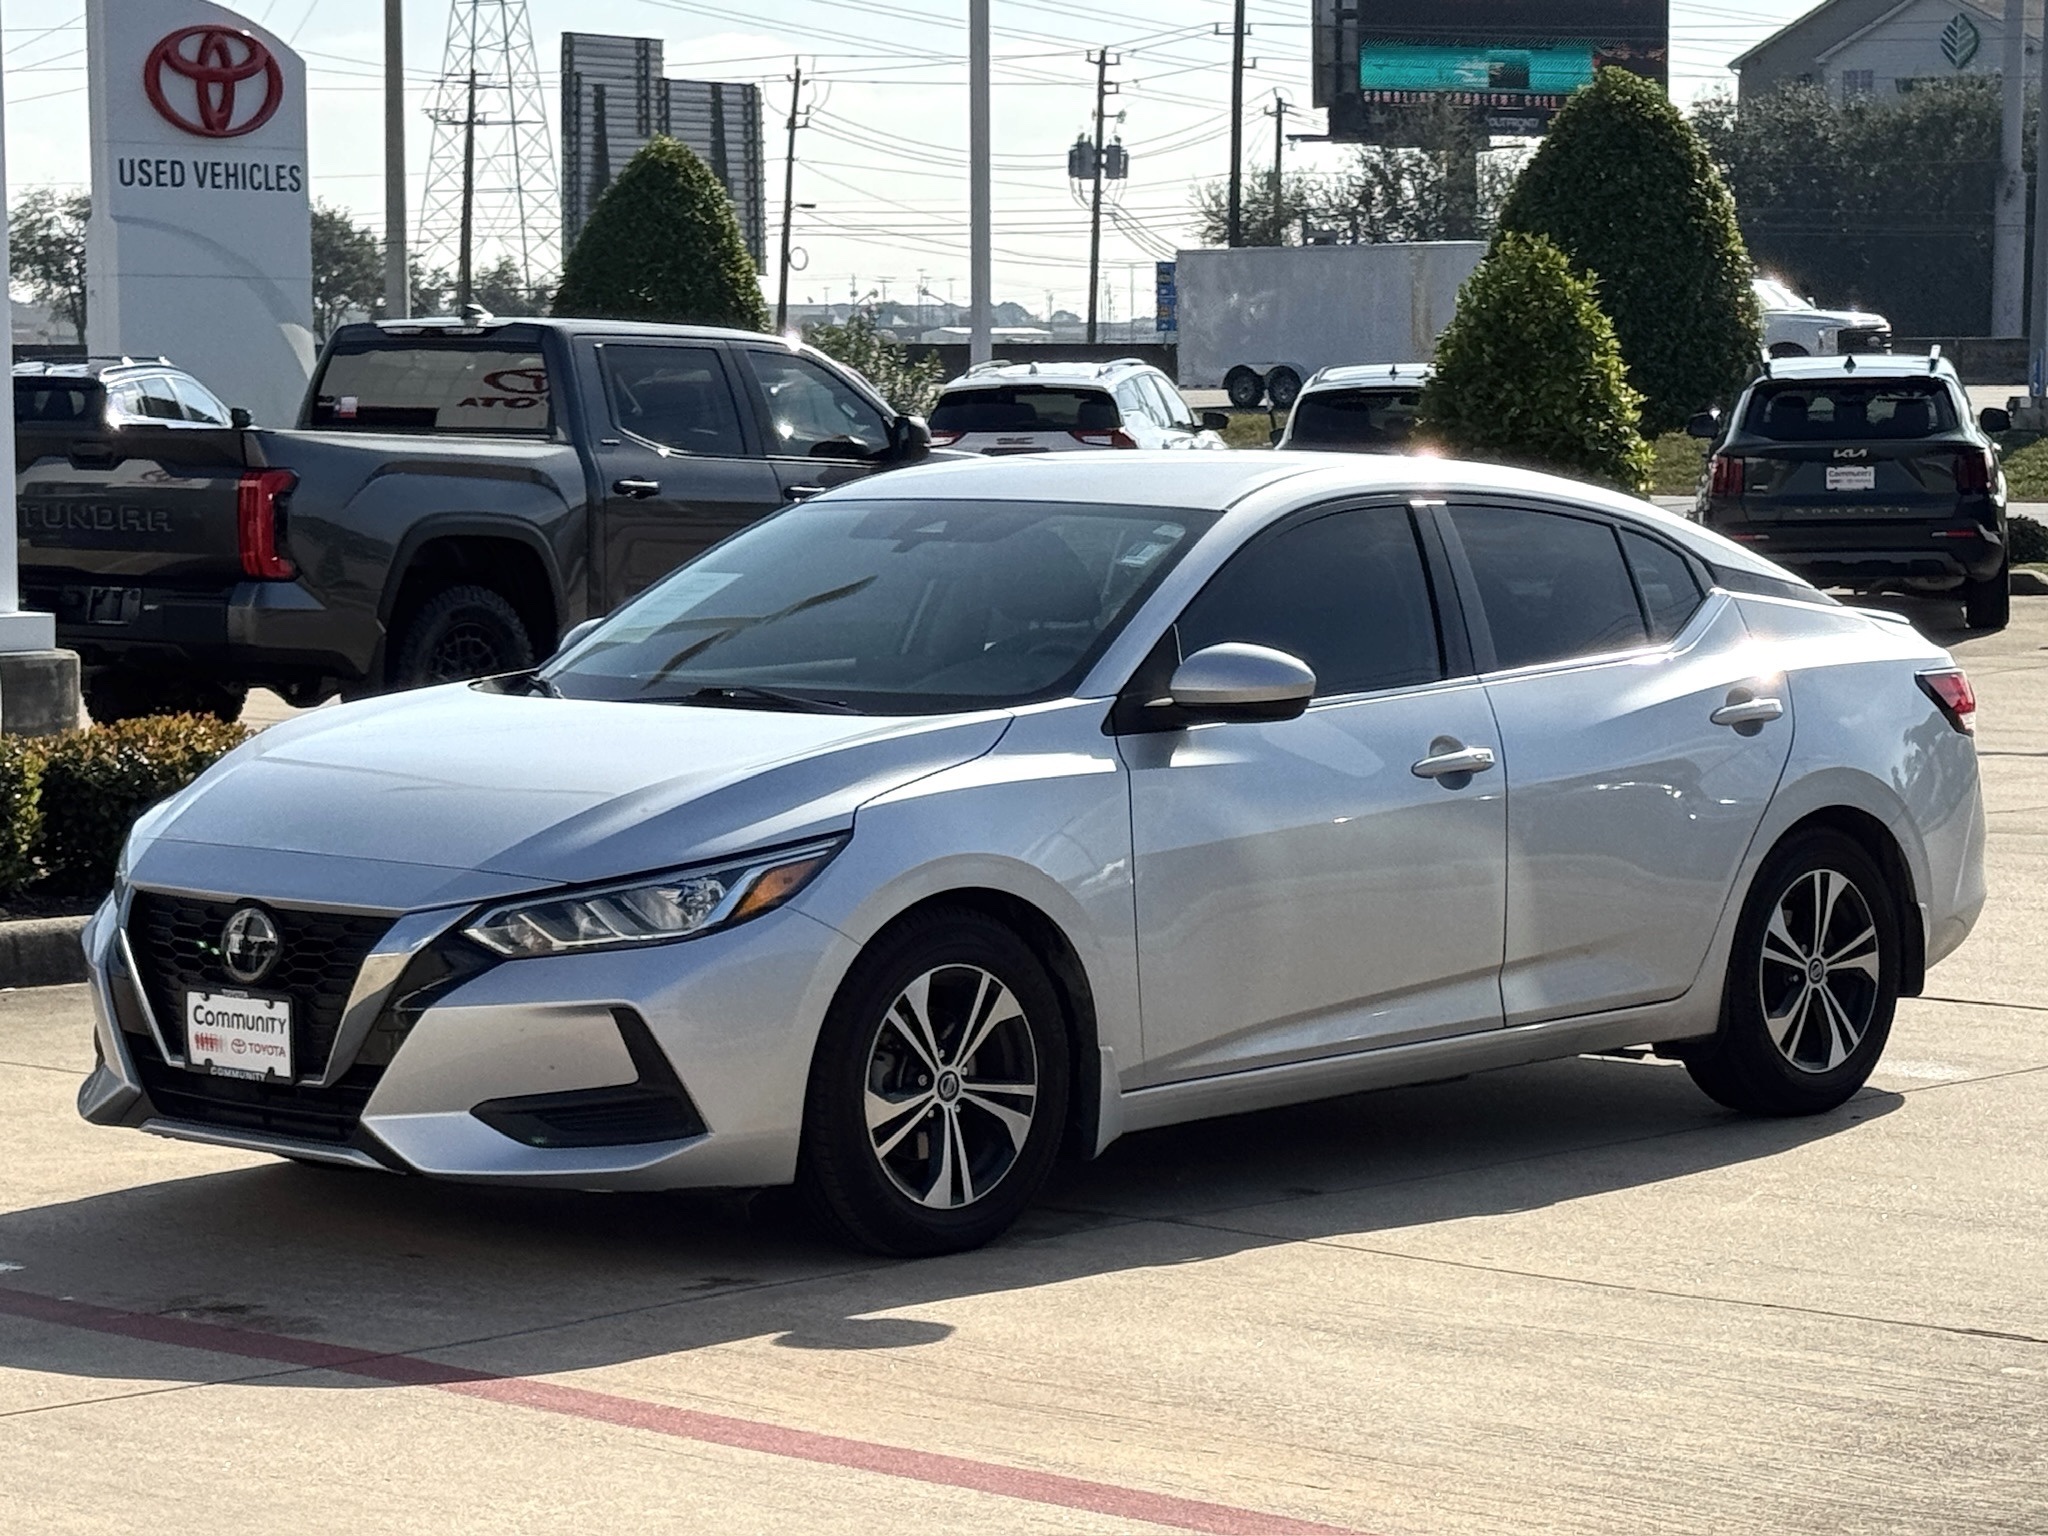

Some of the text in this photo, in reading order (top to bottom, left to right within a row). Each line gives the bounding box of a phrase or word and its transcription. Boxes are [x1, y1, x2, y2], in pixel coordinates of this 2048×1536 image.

[118, 157, 302, 193] USED VEHICLES
[19, 503, 175, 532] TUNDRA
[248, 1042, 287, 1058] TOYOTA
[210, 1066, 266, 1082] COMMUNITY
